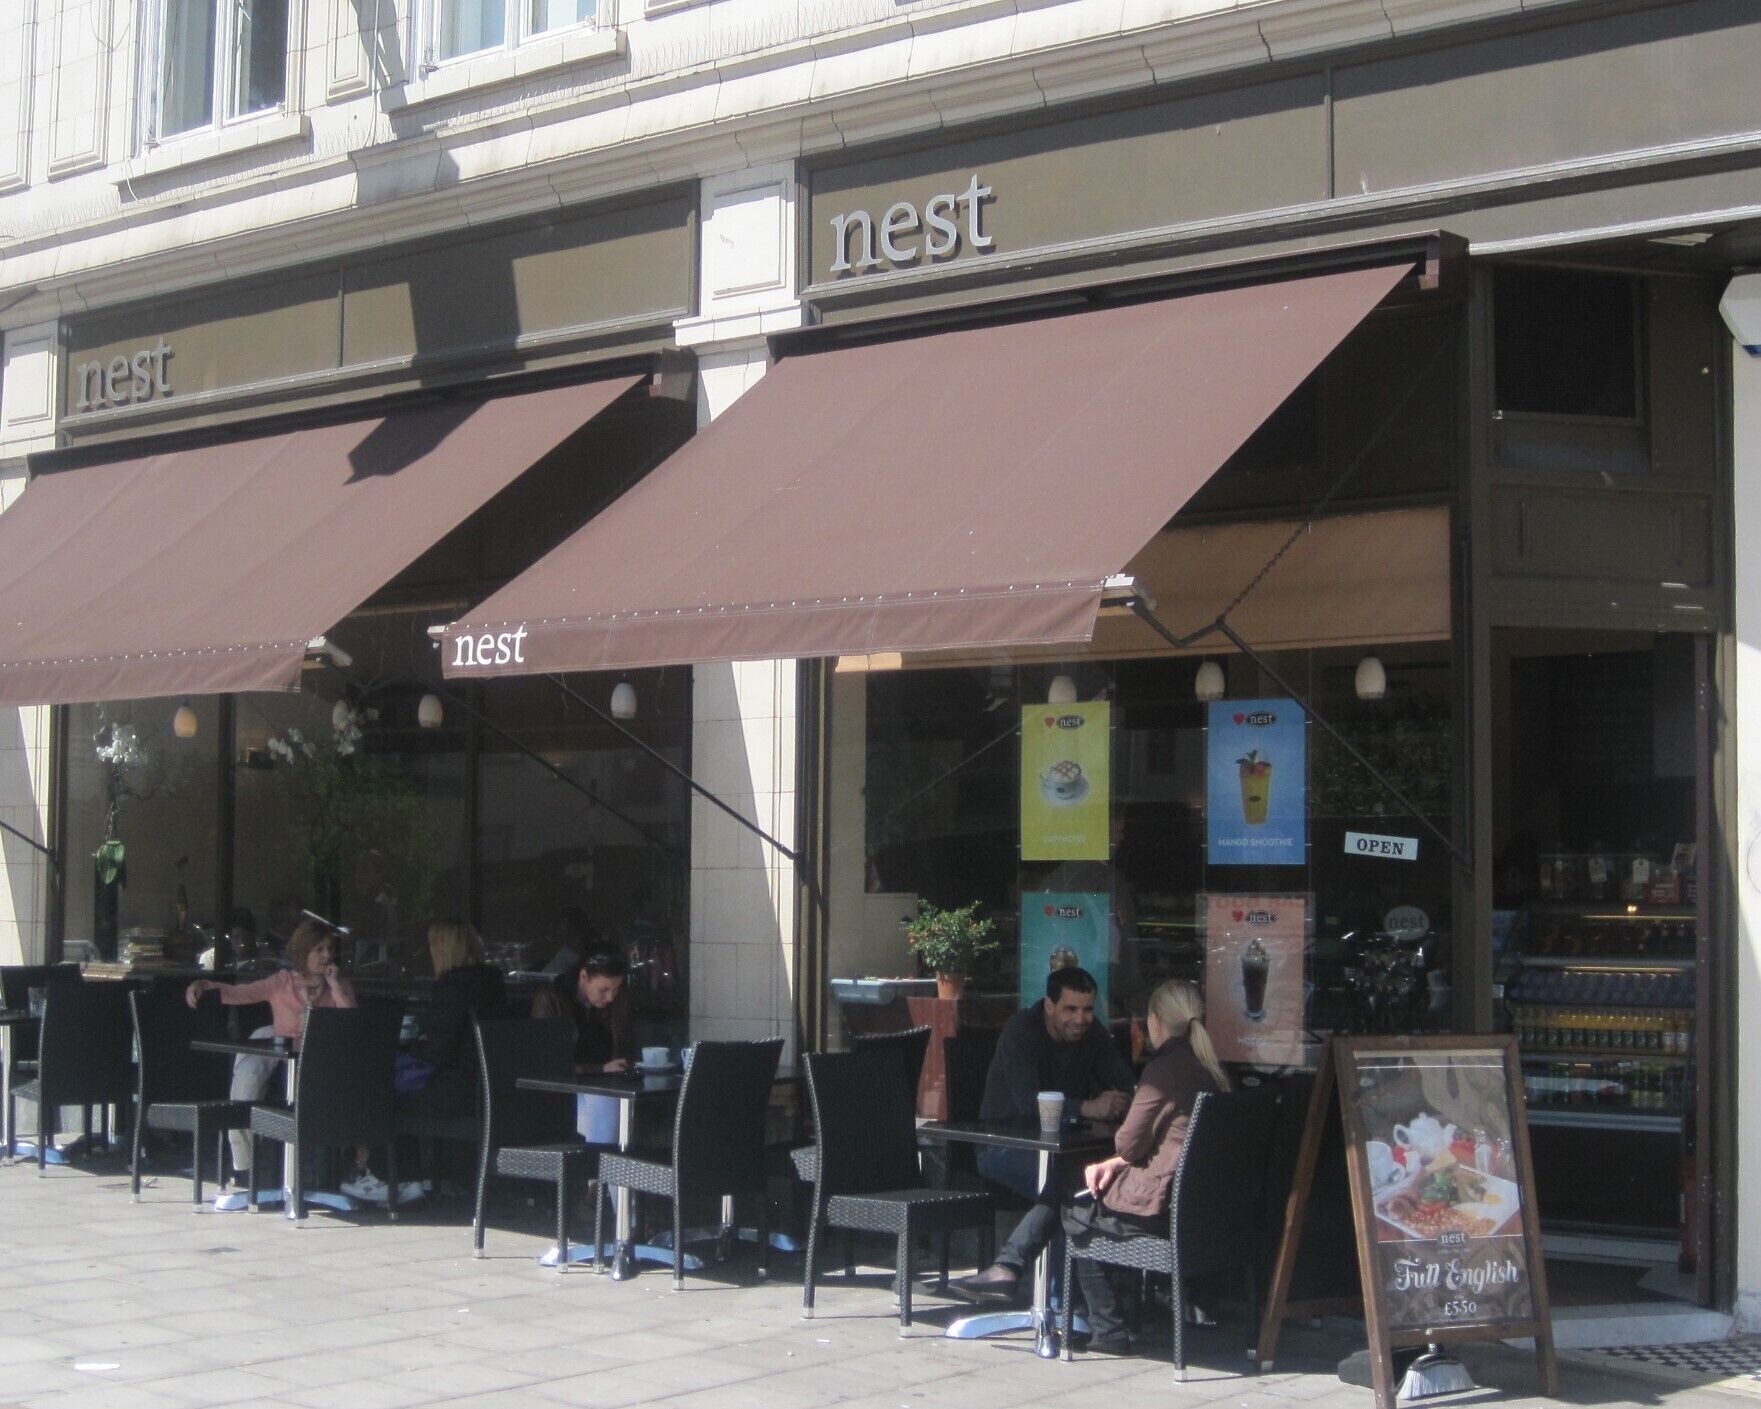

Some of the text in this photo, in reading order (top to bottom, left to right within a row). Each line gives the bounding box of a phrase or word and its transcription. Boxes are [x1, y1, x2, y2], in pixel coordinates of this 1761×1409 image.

[830, 174, 993, 272] nest
[77, 336, 173, 408] nest
[452, 625, 528, 666] nest
[1060, 718, 1081, 727] nest
[1250, 714, 1273, 724] nest
[1356, 838, 1405, 856] OPEN
[1060, 908, 1080, 917] nest
[1248, 913, 1272, 923] nest
[1388, 913, 1425, 929] nest
[1441, 1232, 1466, 1244] nest
[1394, 1257, 1520, 1294] Full English
